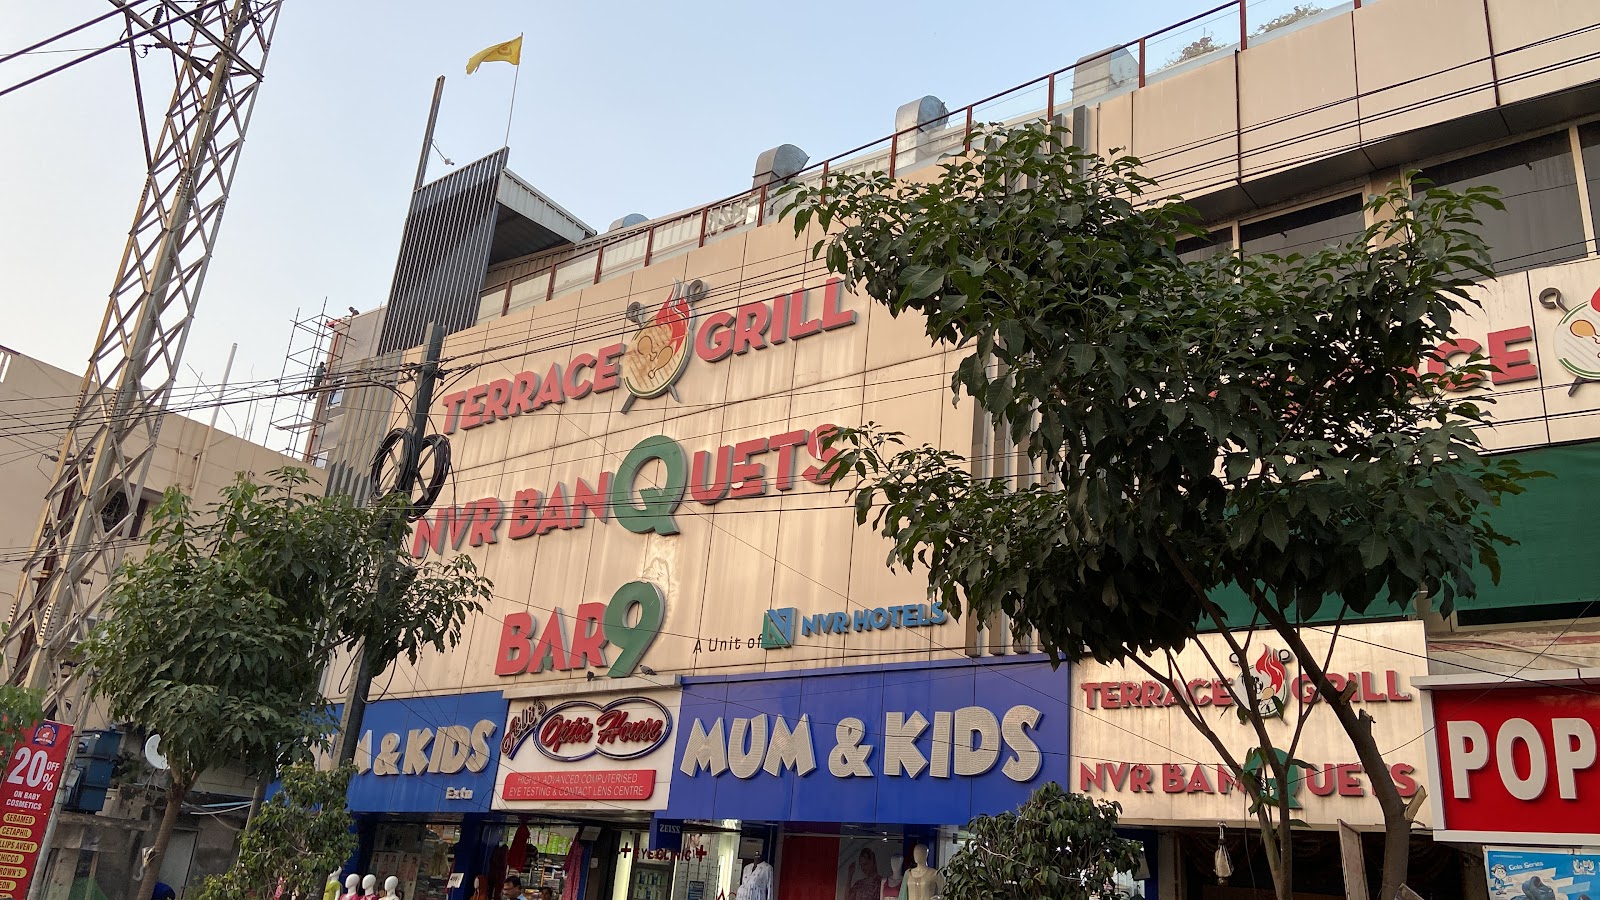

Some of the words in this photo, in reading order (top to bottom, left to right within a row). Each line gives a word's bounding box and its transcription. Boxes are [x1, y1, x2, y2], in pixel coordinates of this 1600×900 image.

[442, 342, 626, 435] TERRACE
[695, 277, 857, 363] GRILL
[411, 497, 504, 559] NVR
[508, 425, 846, 536] BANQUETS
[801, 612, 850, 637] NVR
[853, 601, 948, 633] HOTELS
[693, 639, 702, 654] A
[709, 636, 741, 652] Unit
[747, 633, 763, 649] of
[1081, 678, 1234, 710] TERRACE
[540, 713, 594, 752] Optic
[596, 709, 664, 745] House
[374, 732, 402, 776] &
[402, 719, 498, 776] KIDS
[680, 713, 817, 779] MUM
[828, 717, 873, 779] &
[883, 704, 1043, 782] KIDS
[7, 747, 48, 787] 20
[46, 761, 60, 771] OFF
[517, 775, 540, 785] HIGHLY
[542, 774, 580, 784] ADVANCED
[581, 773, 638, 784] COMPUTERISED
[1080, 762, 1155, 794] NVR
[1162, 747, 1419, 809] BANQUES
[23, 792, 41, 801] BABY
[508, 787, 521, 797] EYE
[523, 787, 551, 796] TESTING
[552, 787, 557, 796] &
[558, 786, 592, 796] CONTACT
[593, 786, 612, 796] LENS
[613, 785, 643, 796] CENTRE
[6, 799, 42, 810] COSMETICS
[5, 814, 33, 825] SEBAMED
[659, 824, 681, 834] ZEISS
[2, 827, 29, 838] CETAPHIL
[15, 842, 34, 851] AVENT
[1524, 861, 1544, 869] Series
